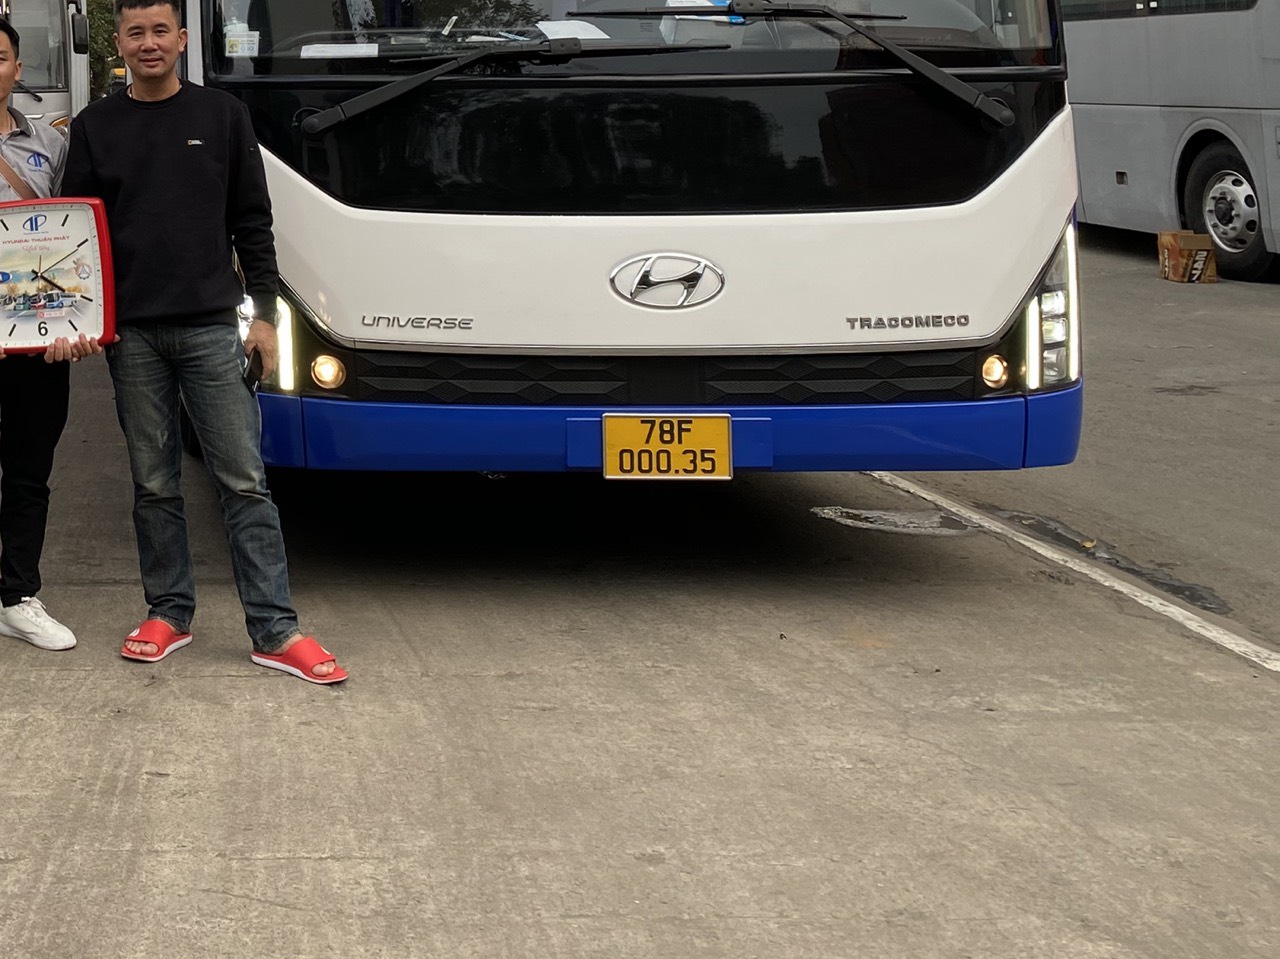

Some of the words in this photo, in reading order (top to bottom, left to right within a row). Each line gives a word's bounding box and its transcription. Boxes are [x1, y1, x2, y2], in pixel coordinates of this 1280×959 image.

[38, 321, 49, 337] 6
[361, 314, 474, 331] UNIVERSE
[846, 314, 970, 330] TRACOMECO
[639, 419, 694, 446] 78F
[618, 448, 717, 475] 000.35
